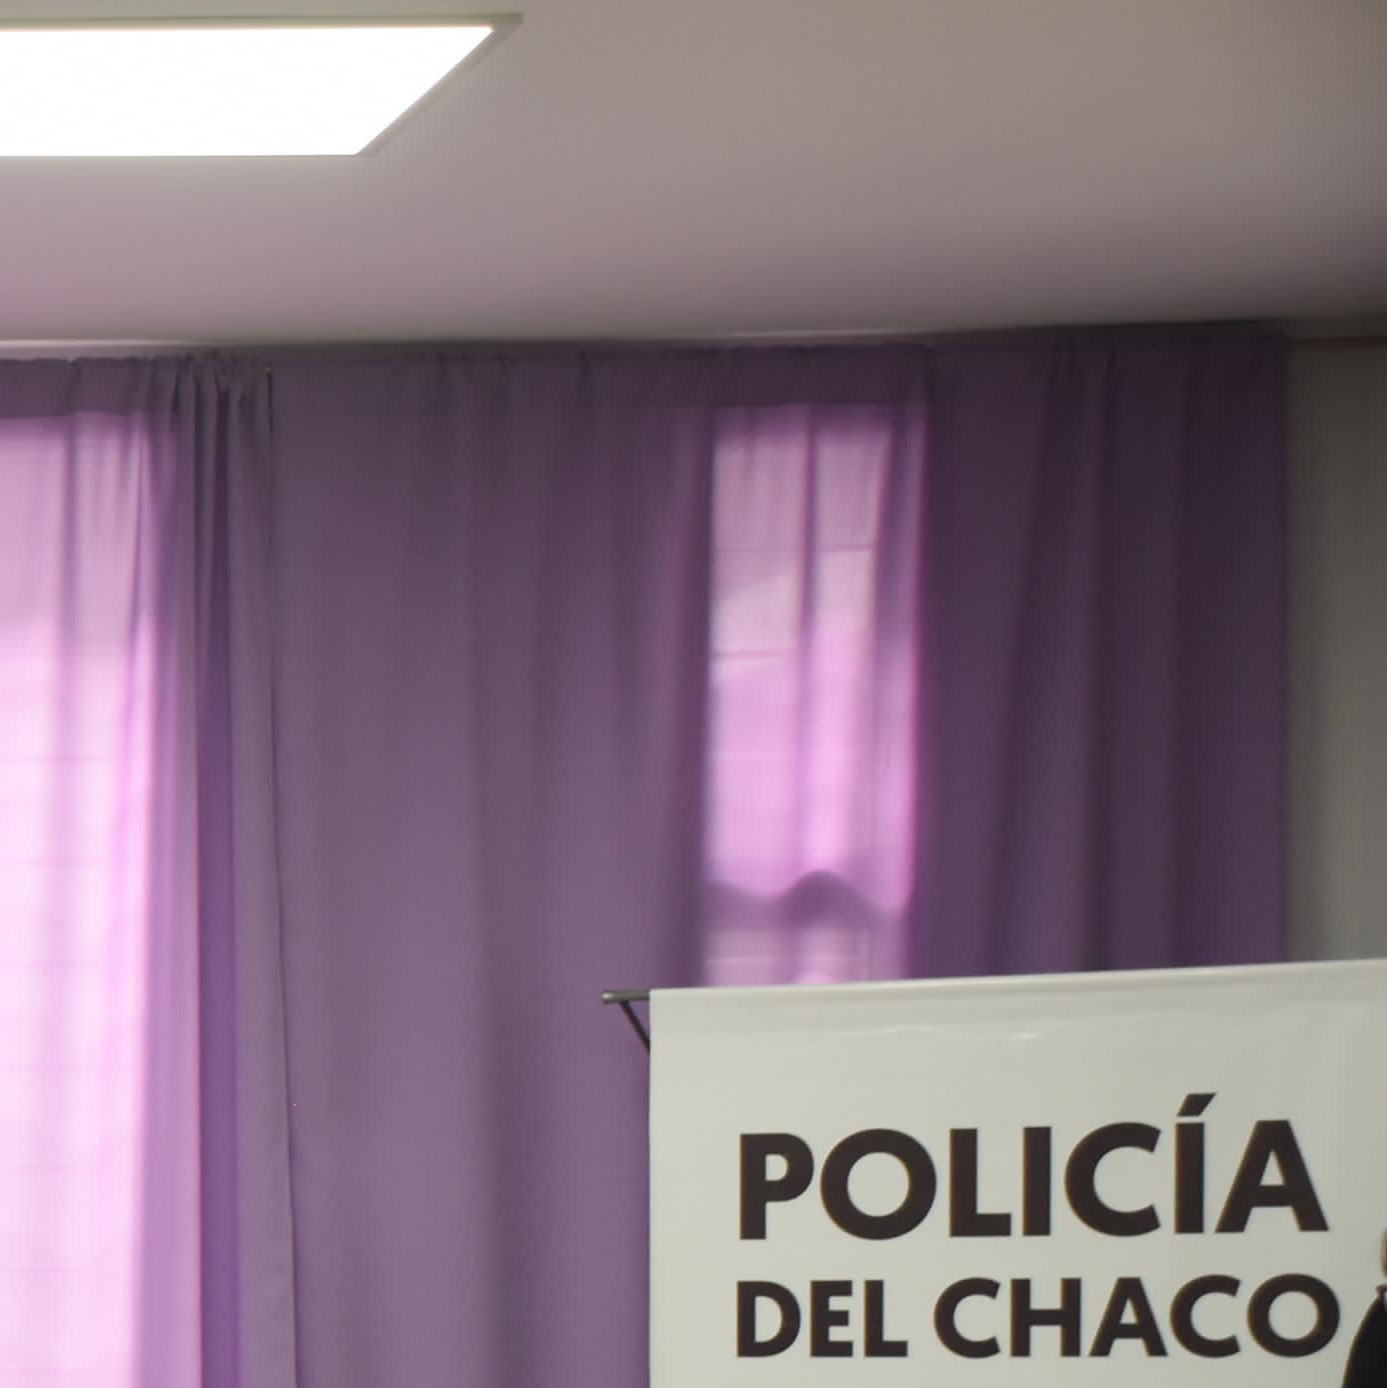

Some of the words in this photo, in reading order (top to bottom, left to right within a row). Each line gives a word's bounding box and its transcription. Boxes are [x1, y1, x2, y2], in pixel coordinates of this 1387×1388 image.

[739, 1092, 1330, 1241] POLICÍA
[736, 1279, 909, 1359] DEL
[933, 1273, 1341, 1360] CHACO
